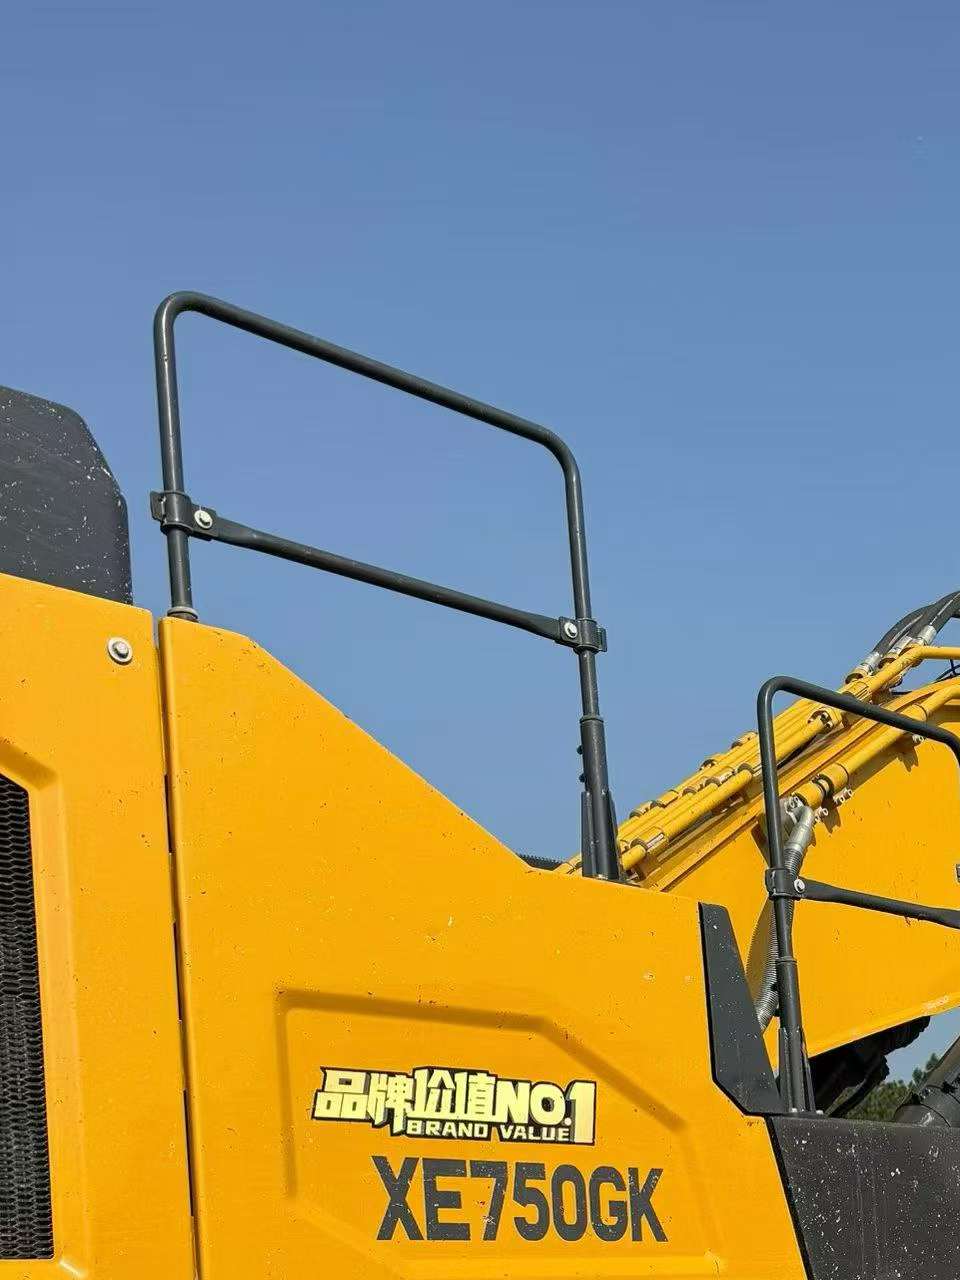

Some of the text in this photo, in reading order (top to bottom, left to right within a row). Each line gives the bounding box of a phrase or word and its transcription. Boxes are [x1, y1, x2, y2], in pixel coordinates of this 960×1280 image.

[407, 1120, 570, 1141] BRAND VALUE
[371, 1155, 668, 1242] XE750GK
